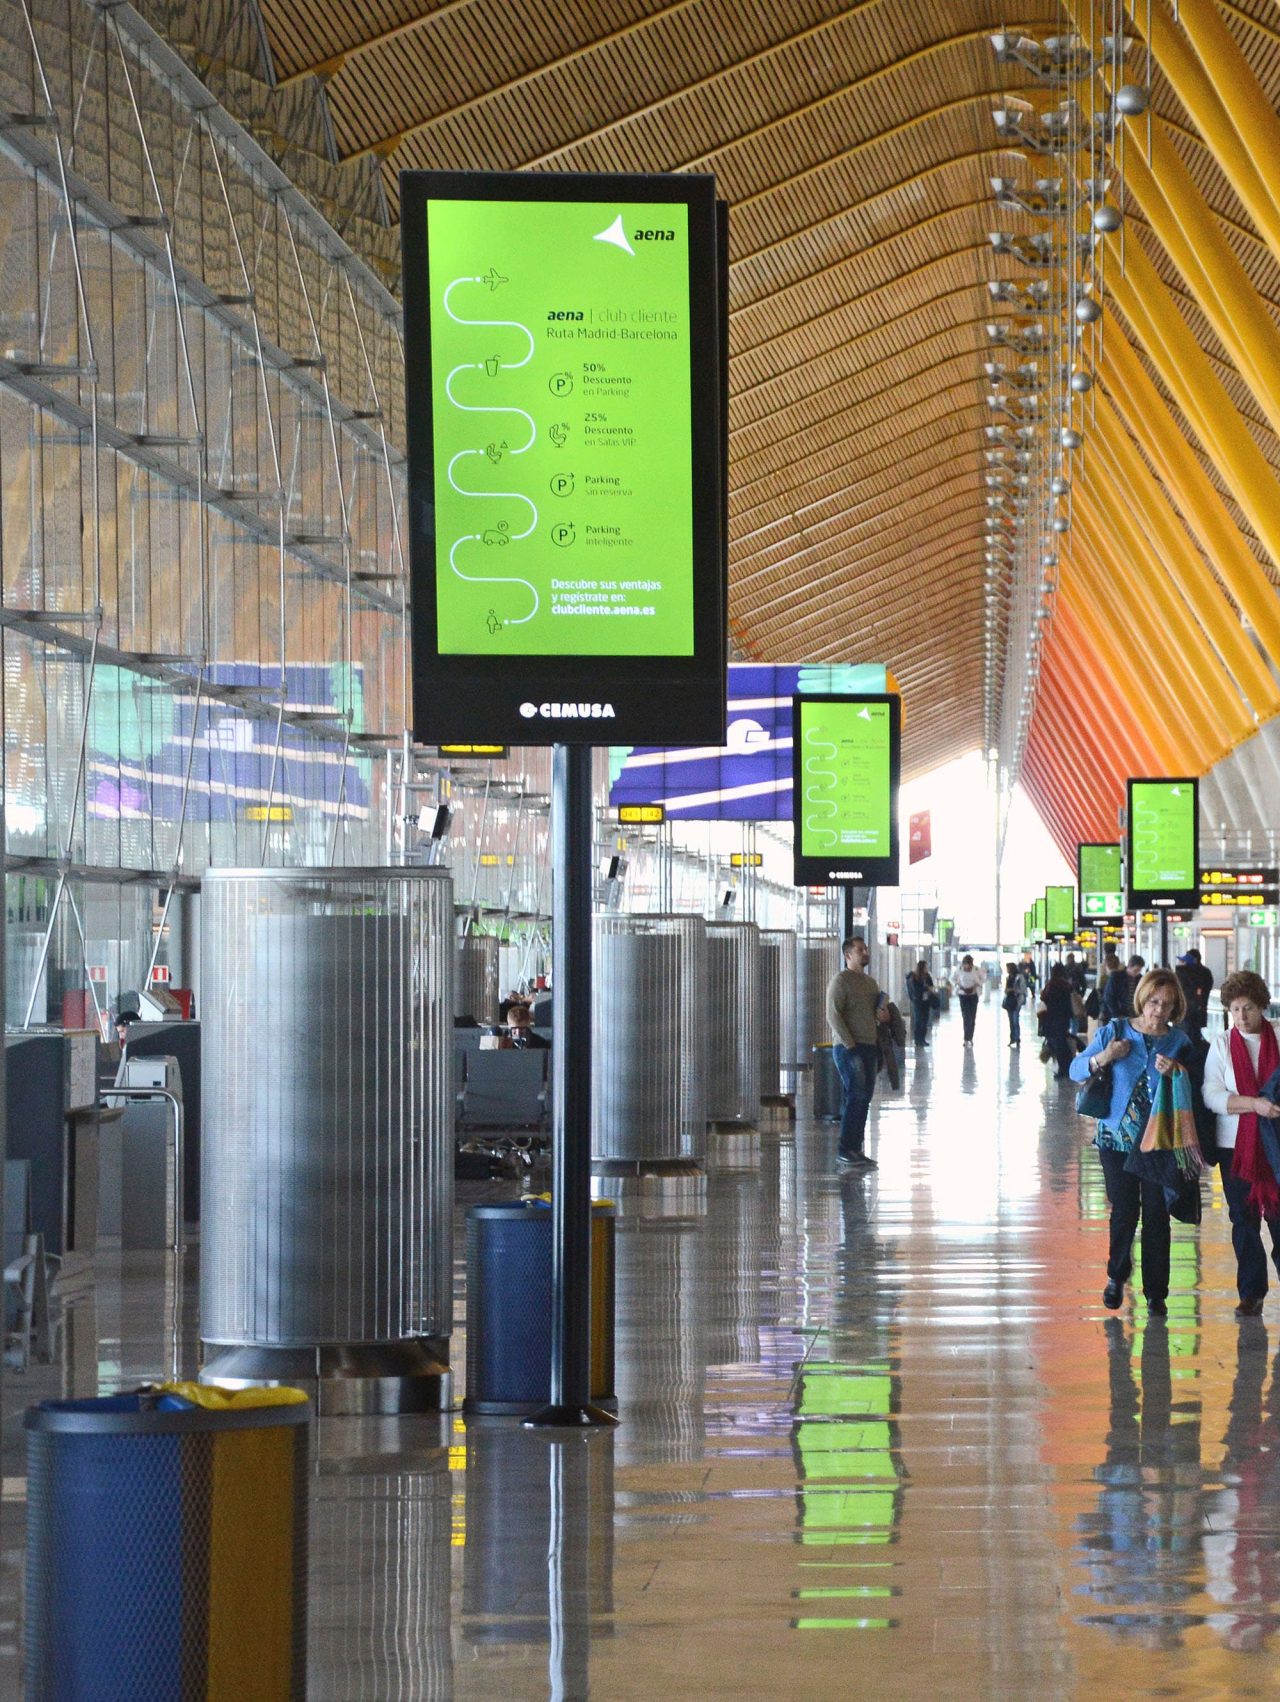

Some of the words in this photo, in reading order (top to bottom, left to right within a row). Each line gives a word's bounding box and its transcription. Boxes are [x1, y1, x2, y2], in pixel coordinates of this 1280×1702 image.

[634, 229, 676, 241] aena
[547, 310, 585, 321] aena
[598, 308, 627, 323] club
[631, 308, 678, 323] cliente
[546, 327, 575, 339] Ruta
[577, 327, 679, 340] Madrid-Barcelona
[583, 363, 606, 373] 50%
[583, 375, 632, 385] Descuento
[583, 388, 595, 396] en
[596, 388, 630, 398] Parking
[584, 413, 608, 422] 25%
[584, 425, 634, 435] Descuento
[599, 438, 620, 447] Salas
[622, 438, 637, 447] VIP
[585, 475, 621, 485] Parking
[585, 488, 598, 496] sin
[599, 488, 633, 497] reserva
[585, 525, 621, 536] Parking
[585, 538, 633, 548] inteligente
[551, 579, 598, 590] Descubre
[600, 581, 617, 590] sus
[619, 580, 662, 592] ventajas
[551, 593, 558, 603] y
[610, 593, 626, 602] en:
[551, 603, 656, 616] clubcliente.aena.es
[539, 703, 616, 718] CEMUSA
